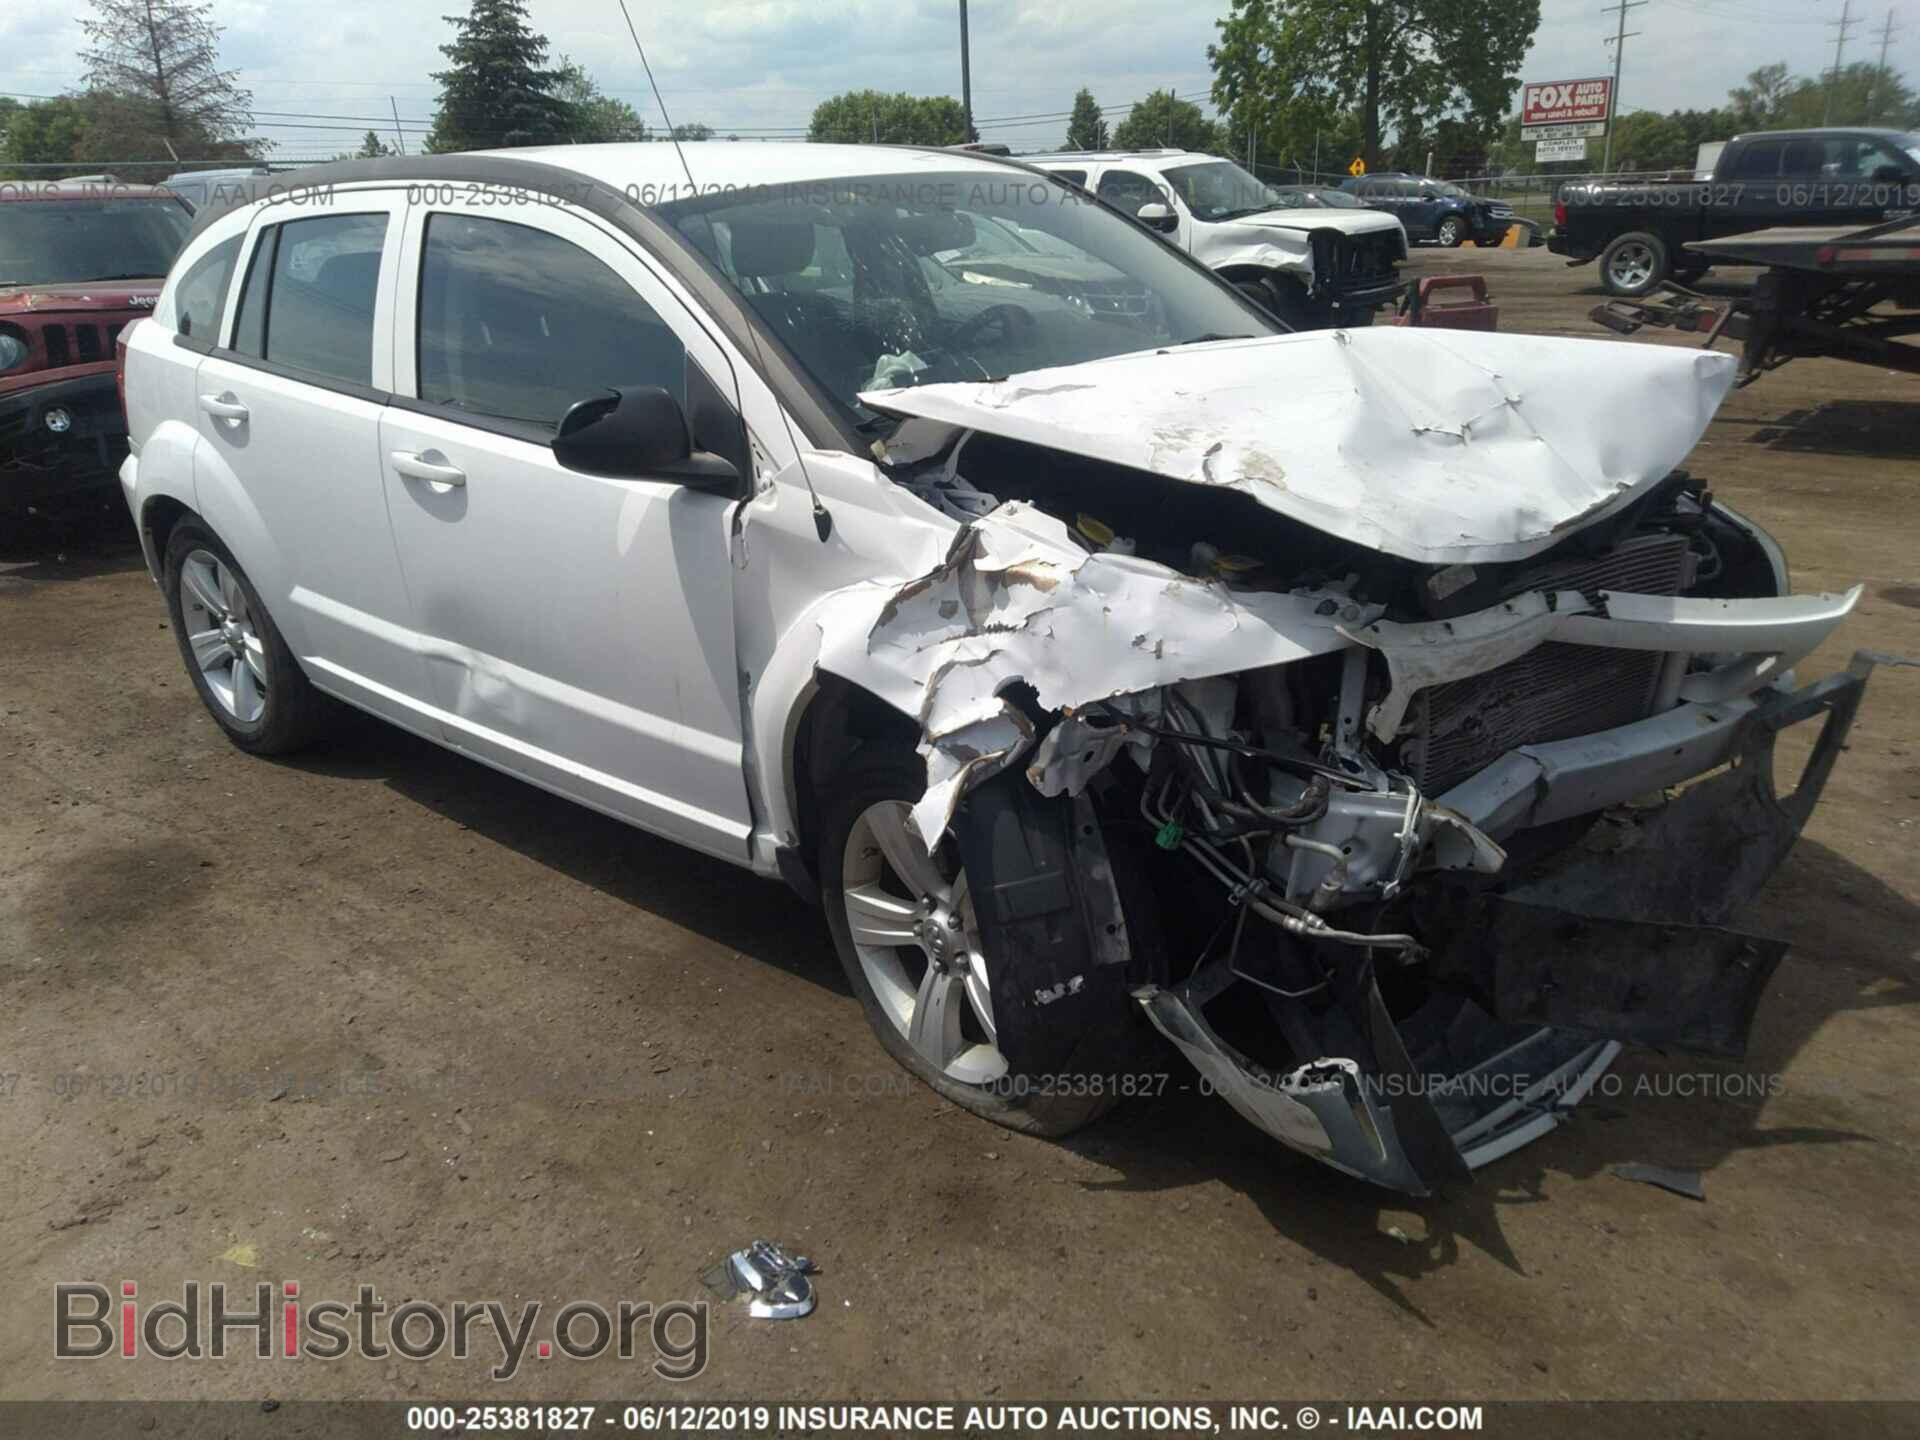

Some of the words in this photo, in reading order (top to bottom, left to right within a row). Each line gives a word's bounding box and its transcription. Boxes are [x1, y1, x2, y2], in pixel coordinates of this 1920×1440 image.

[1576, 82, 1603, 94] AUTO
[1527, 85, 1575, 110] FOX
[1574, 94, 1605, 106] PARTS
